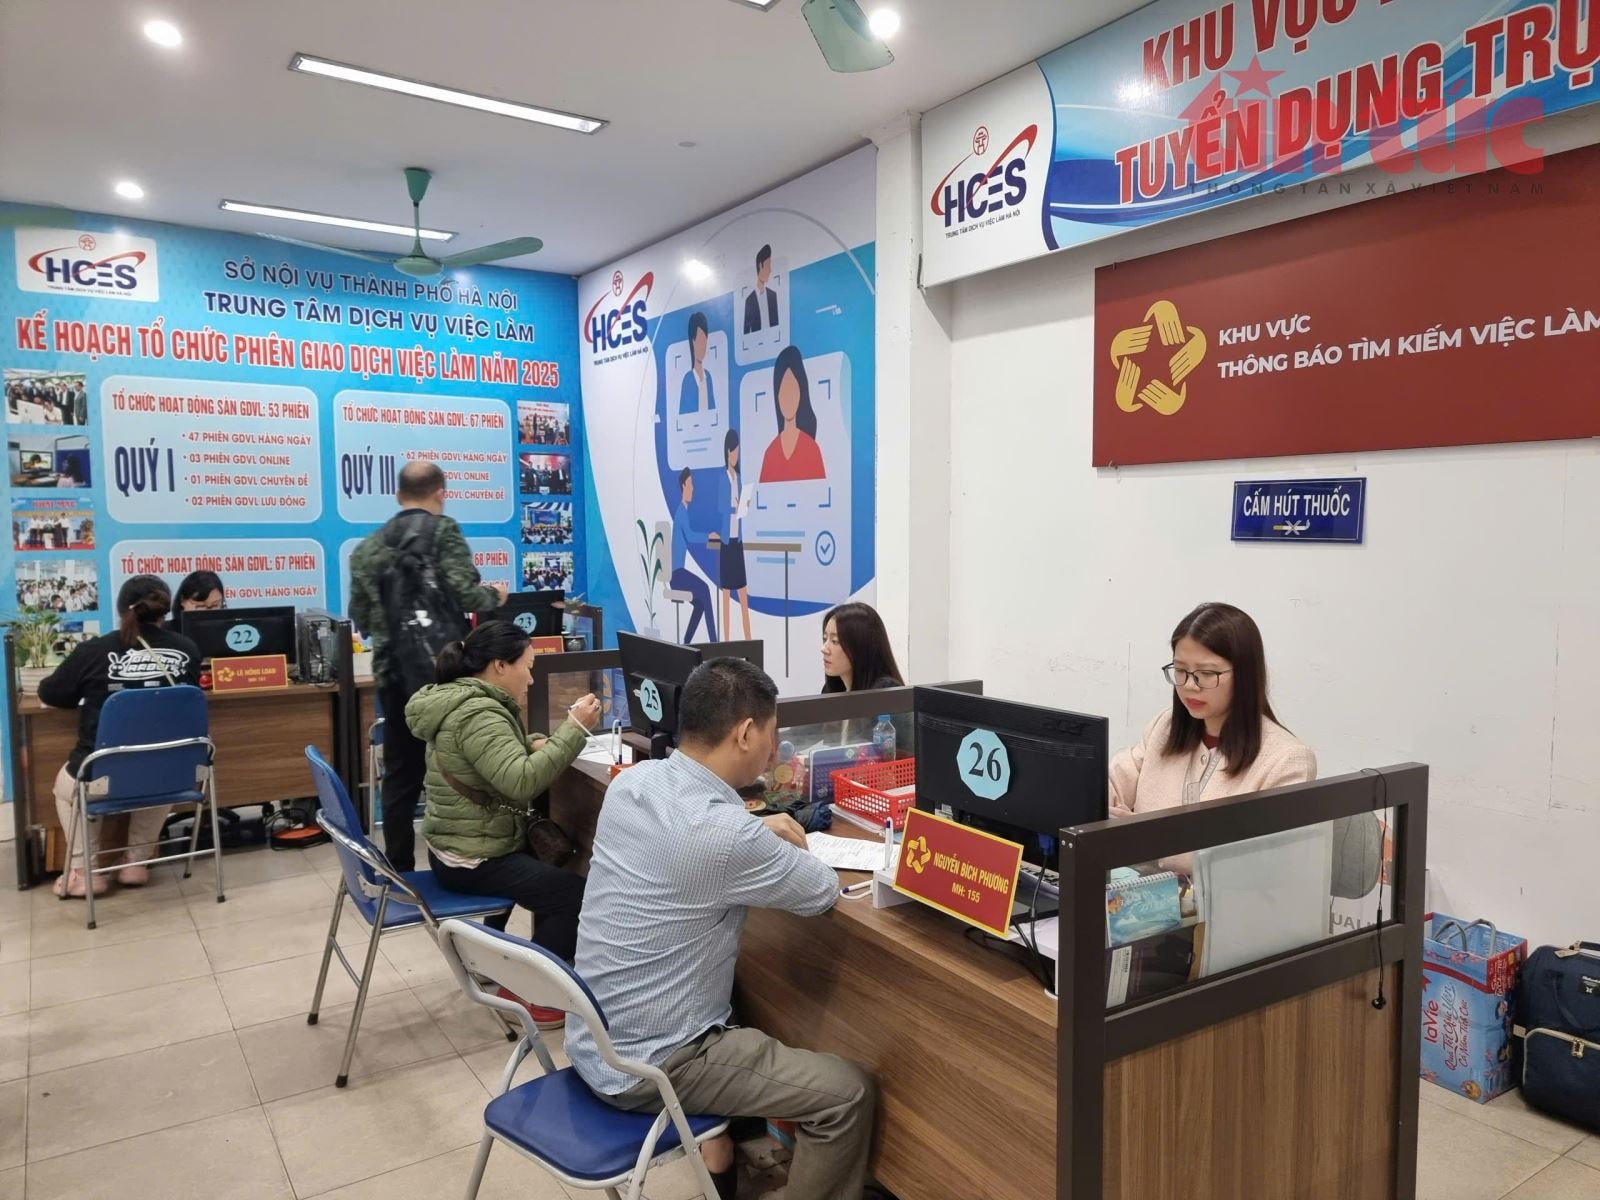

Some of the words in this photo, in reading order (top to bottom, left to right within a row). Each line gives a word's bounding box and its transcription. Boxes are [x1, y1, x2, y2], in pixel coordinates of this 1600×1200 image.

[1143, 3, 1234, 90] KHU
[1115, 89, 1261, 204] TUYỂN
[1278, 42, 1445, 160] DỤNG
[945, 158, 1027, 227] HCES
[46, 256, 137, 290] HCES
[224, 256, 255, 281] SỞ
[262, 263, 298, 288] NỘI
[306, 270, 333, 291] VỤ
[340, 271, 407, 298] THÀNH
[489, 288, 517, 311] NỘI
[204, 291, 286, 318] TRUNG
[295, 297, 340, 324] TÂM
[349, 309, 403, 333] DỊCH
[411, 313, 437, 338] VỤ
[445, 315, 489, 343] VIỆC
[496, 318, 534, 343] LÀM
[592, 300, 648, 354] HCES
[1219, 324, 1260, 346] KHU
[1267, 313, 1311, 341] VỰC
[16, 309, 48, 351] KẾ
[54, 321, 131, 361] HOẠCH
[138, 317, 164, 358] TỔ
[172, 327, 228, 363] CHỨC
[235, 331, 295, 368] PHIÊN
[302, 342, 344, 371] GIAO
[351, 346, 392, 380] DỊCH
[398, 350, 435, 385] VIỆC
[441, 349, 475, 381] LÀM
[481, 352, 518, 385] NĂM
[523, 361, 559, 388] 2025
[1218, 353, 1288, 379] THÔNG
[1295, 344, 1342, 369] BÁO
[1348, 337, 1390, 361] TÌM
[1398, 323, 1462, 356] KIẾM
[1470, 316, 1536, 348] VIỆC
[112, 388, 125, 410] TỔ
[129, 392, 155, 412] CHỨC
[159, 397, 184, 417] HOẠT
[188, 396, 214, 418] ĐỘNG
[268, 404, 280, 418] 53
[282, 400, 309, 419] PHIÊN
[343, 404, 353, 422] TỔ
[357, 405, 378, 423] CHỨC
[381, 408, 400, 427] HOẠT
[404, 408, 426, 428] ĐỘNG
[471, 415, 479, 428] 67
[481, 411, 504, 428] PHIÊN
[188, 432, 199, 441] 47
[202, 431, 229, 443] PHIÊN
[232, 434, 256, 444] GDVL
[258, 432, 284, 444] HÀNG
[287, 433, 311, 446] NGÀY
[114, 438, 159, 498] QUÝ
[167, 448, 175, 492] I
[189, 454, 200, 463] 03
[204, 453, 230, 464] PHIÊN
[233, 455, 256, 465] GDVL
[259, 456, 290, 465] ONLINE
[341, 446, 373, 499] QUÝ
[380, 455, 396, 495] III
[192, 497, 203, 506] 02
[206, 495, 232, 506] PHIÊN
[235, 497, 258, 506] GDVL
[1243, 488, 1270, 517] CẤM
[1273, 488, 1300, 517] HÚT
[1303, 485, 1351, 517] THUỐC
[122, 552, 134, 574] TỔ
[137, 554, 164, 573] CHỨC
[167, 557, 193, 577] HOẠT
[275, 556, 286, 571] 67
[289, 553, 315, 571] PHIÊN
[475, 553, 484, 566] 68
[486, 548, 508, 566] PHIÊN
[232, 629, 253, 645] 22
[518, 616, 532, 629] 23
[645, 687, 659, 711] 25
[969, 742, 1002, 782] 26
[933, 852, 960, 875] NGUYỄN
[960, 860, 978, 882] BÍCH
[952, 882, 965, 897] MH:
[968, 889, 980, 903] 155
